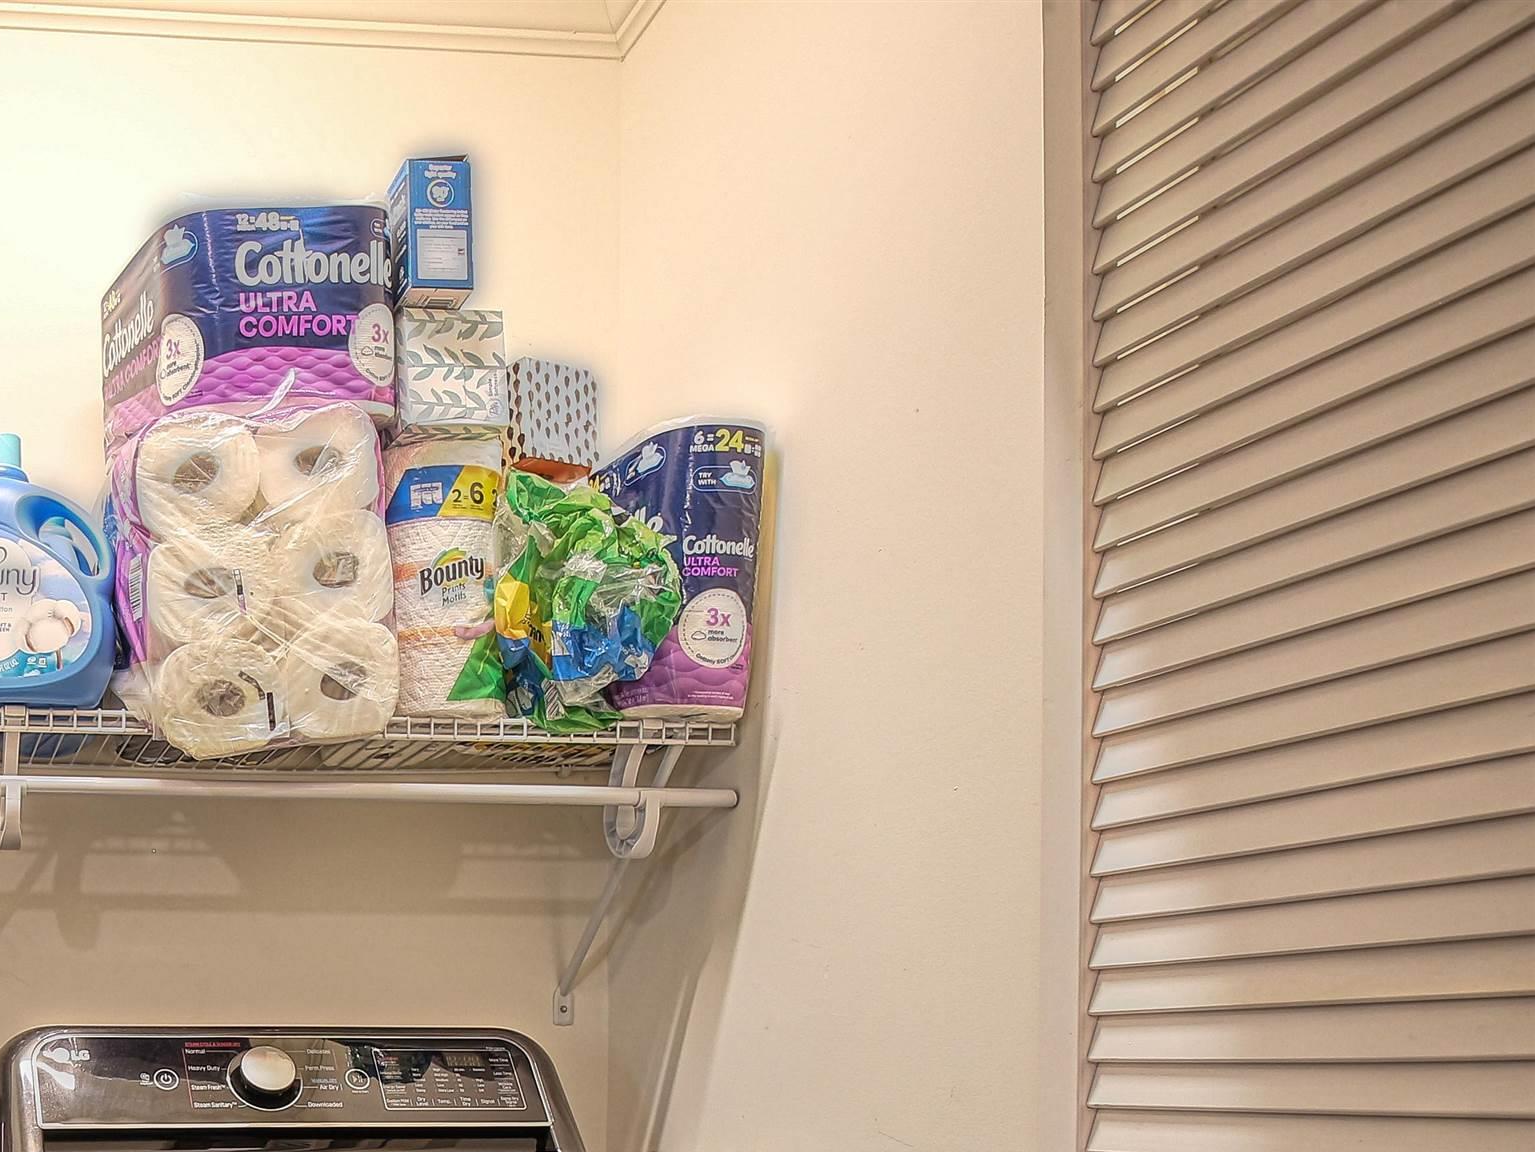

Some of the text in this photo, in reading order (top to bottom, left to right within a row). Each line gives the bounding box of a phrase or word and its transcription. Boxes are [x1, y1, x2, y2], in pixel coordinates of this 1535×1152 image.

[255, 211, 281, 231] 48
[235, 238, 393, 289] Cottonelle
[239, 290, 316, 313] ULTRA
[103, 290, 154, 378] Cottonelle
[239, 314, 360, 337] COMFORT
[371, 322, 390, 345] 3x
[165, 338, 182, 361] 3x
[689, 443, 715, 453] MEGA
[693, 430, 705, 445] 6
[715, 428, 744, 453] 24
[451, 488, 462, 503] 2
[469, 481, 485, 505] 6
[681, 534, 755, 560] Cottonelle
[681, 566, 739, 578] COMFORT
[683, 556, 720, 567] ULTRA
[419, 555, 485, 597] Bounty
[442, 583, 466, 597] Prints
[706, 607, 732, 627] 3x
[70, 1049, 90, 1061] LG
